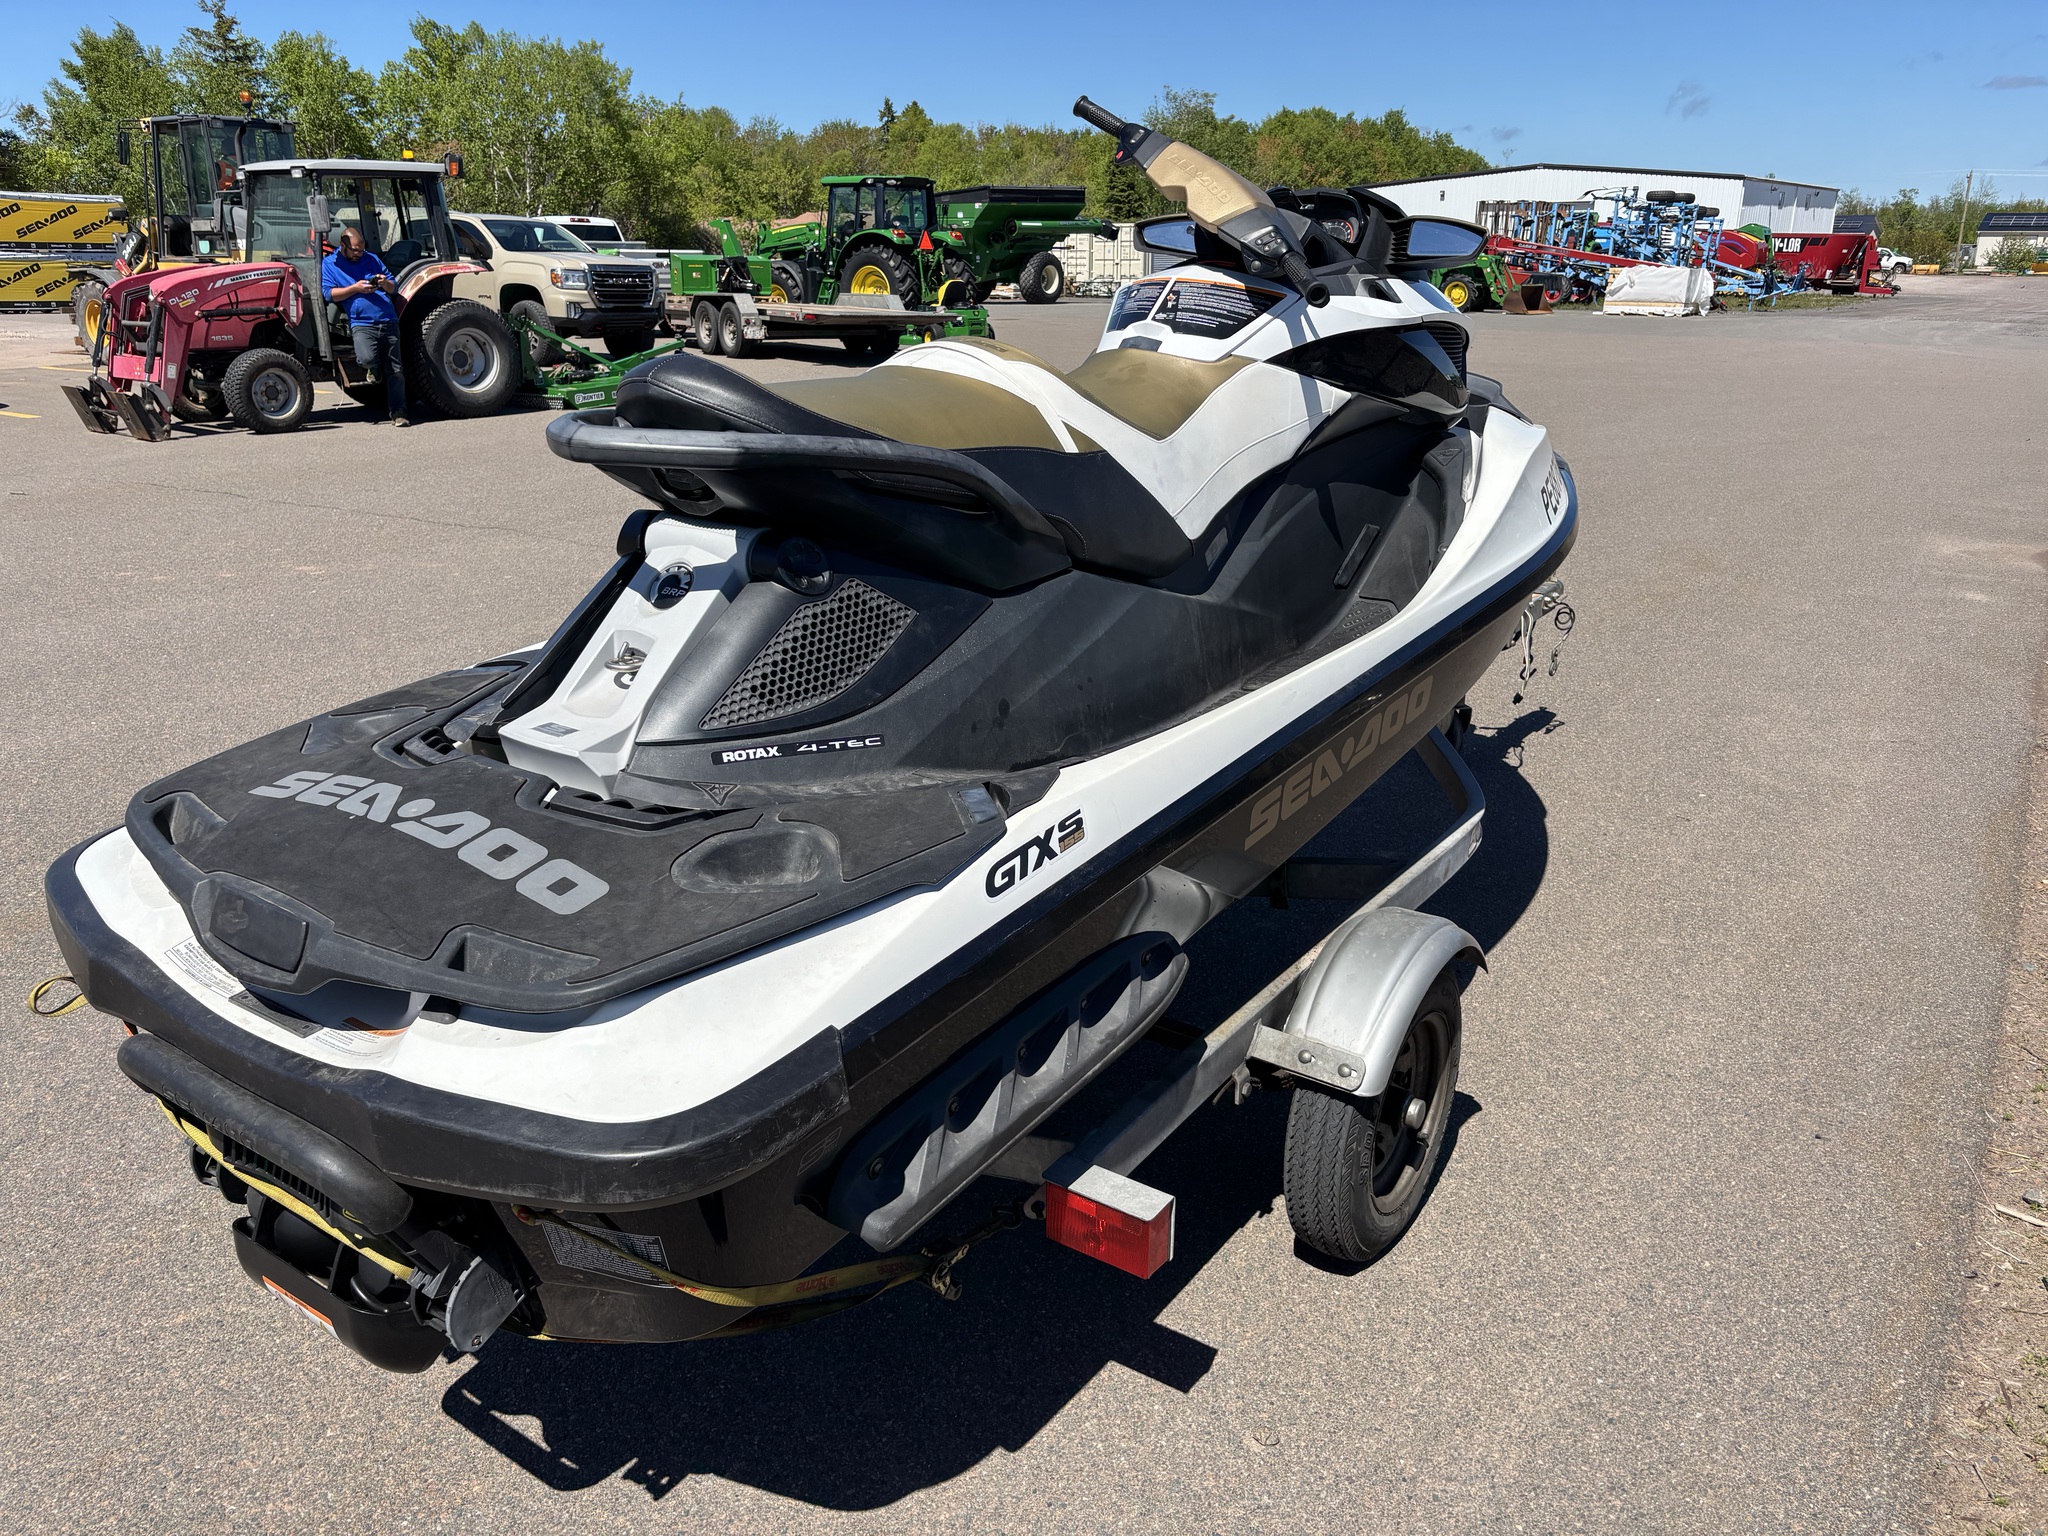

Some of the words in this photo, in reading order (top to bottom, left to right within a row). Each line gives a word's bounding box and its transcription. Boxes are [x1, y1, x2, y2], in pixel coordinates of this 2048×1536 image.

[661, 586, 686, 597] BRP
[722, 746, 782, 763] ROTAX
[1059, 828, 1085, 854] 155
